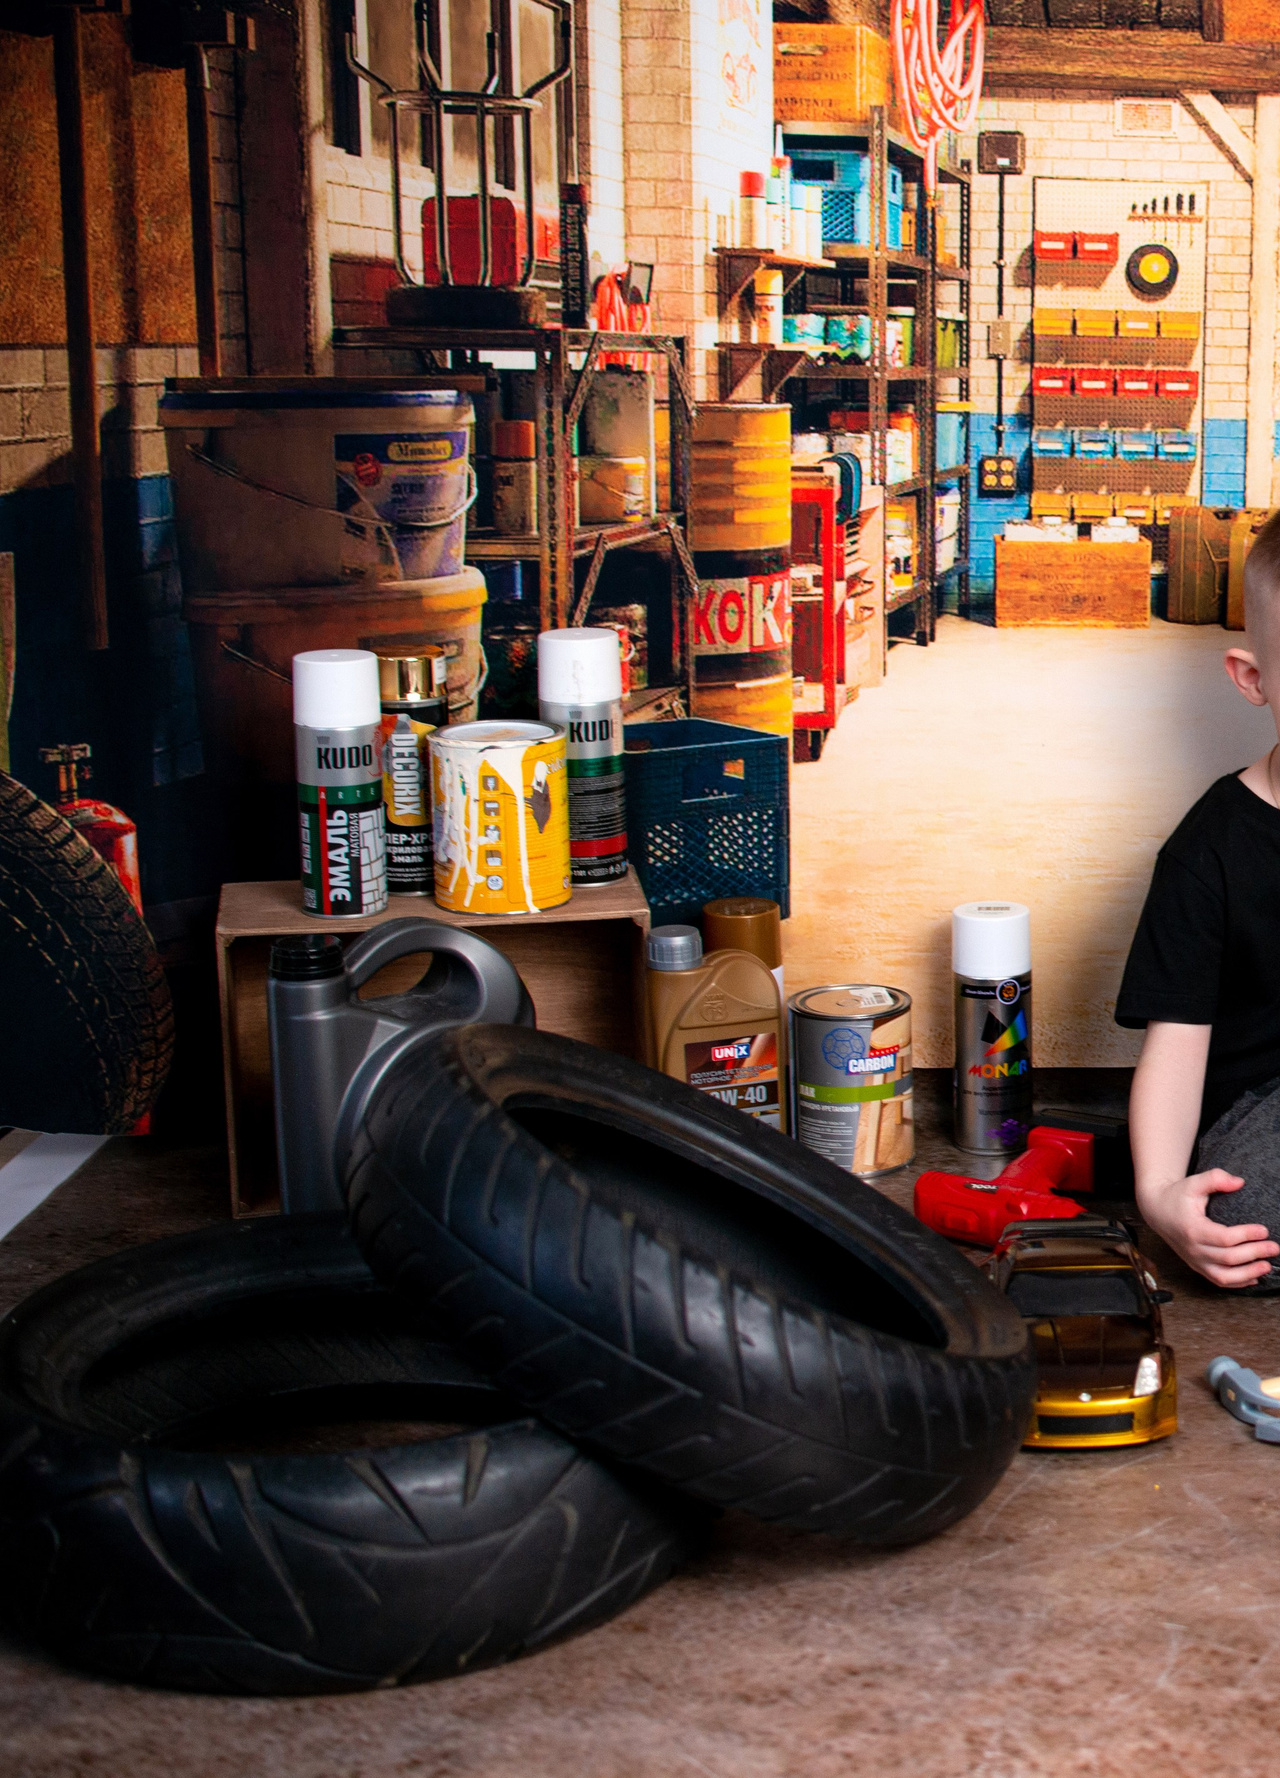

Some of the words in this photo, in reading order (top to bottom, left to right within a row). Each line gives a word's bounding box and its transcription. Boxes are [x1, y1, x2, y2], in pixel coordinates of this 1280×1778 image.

[569, 720, 614, 743] KUD
[317, 744, 373, 770] KUDO
[391, 733, 422, 817] DECORIX
[349, 812, 360, 858] МАТОВАЯ
[385, 832, 432, 845] ПЕР-ХР
[326, 809, 352, 902] ЭМАЛЬ
[849, 1054, 894, 1073] CARBON
[711, 1085, 767, 1106] W-40
